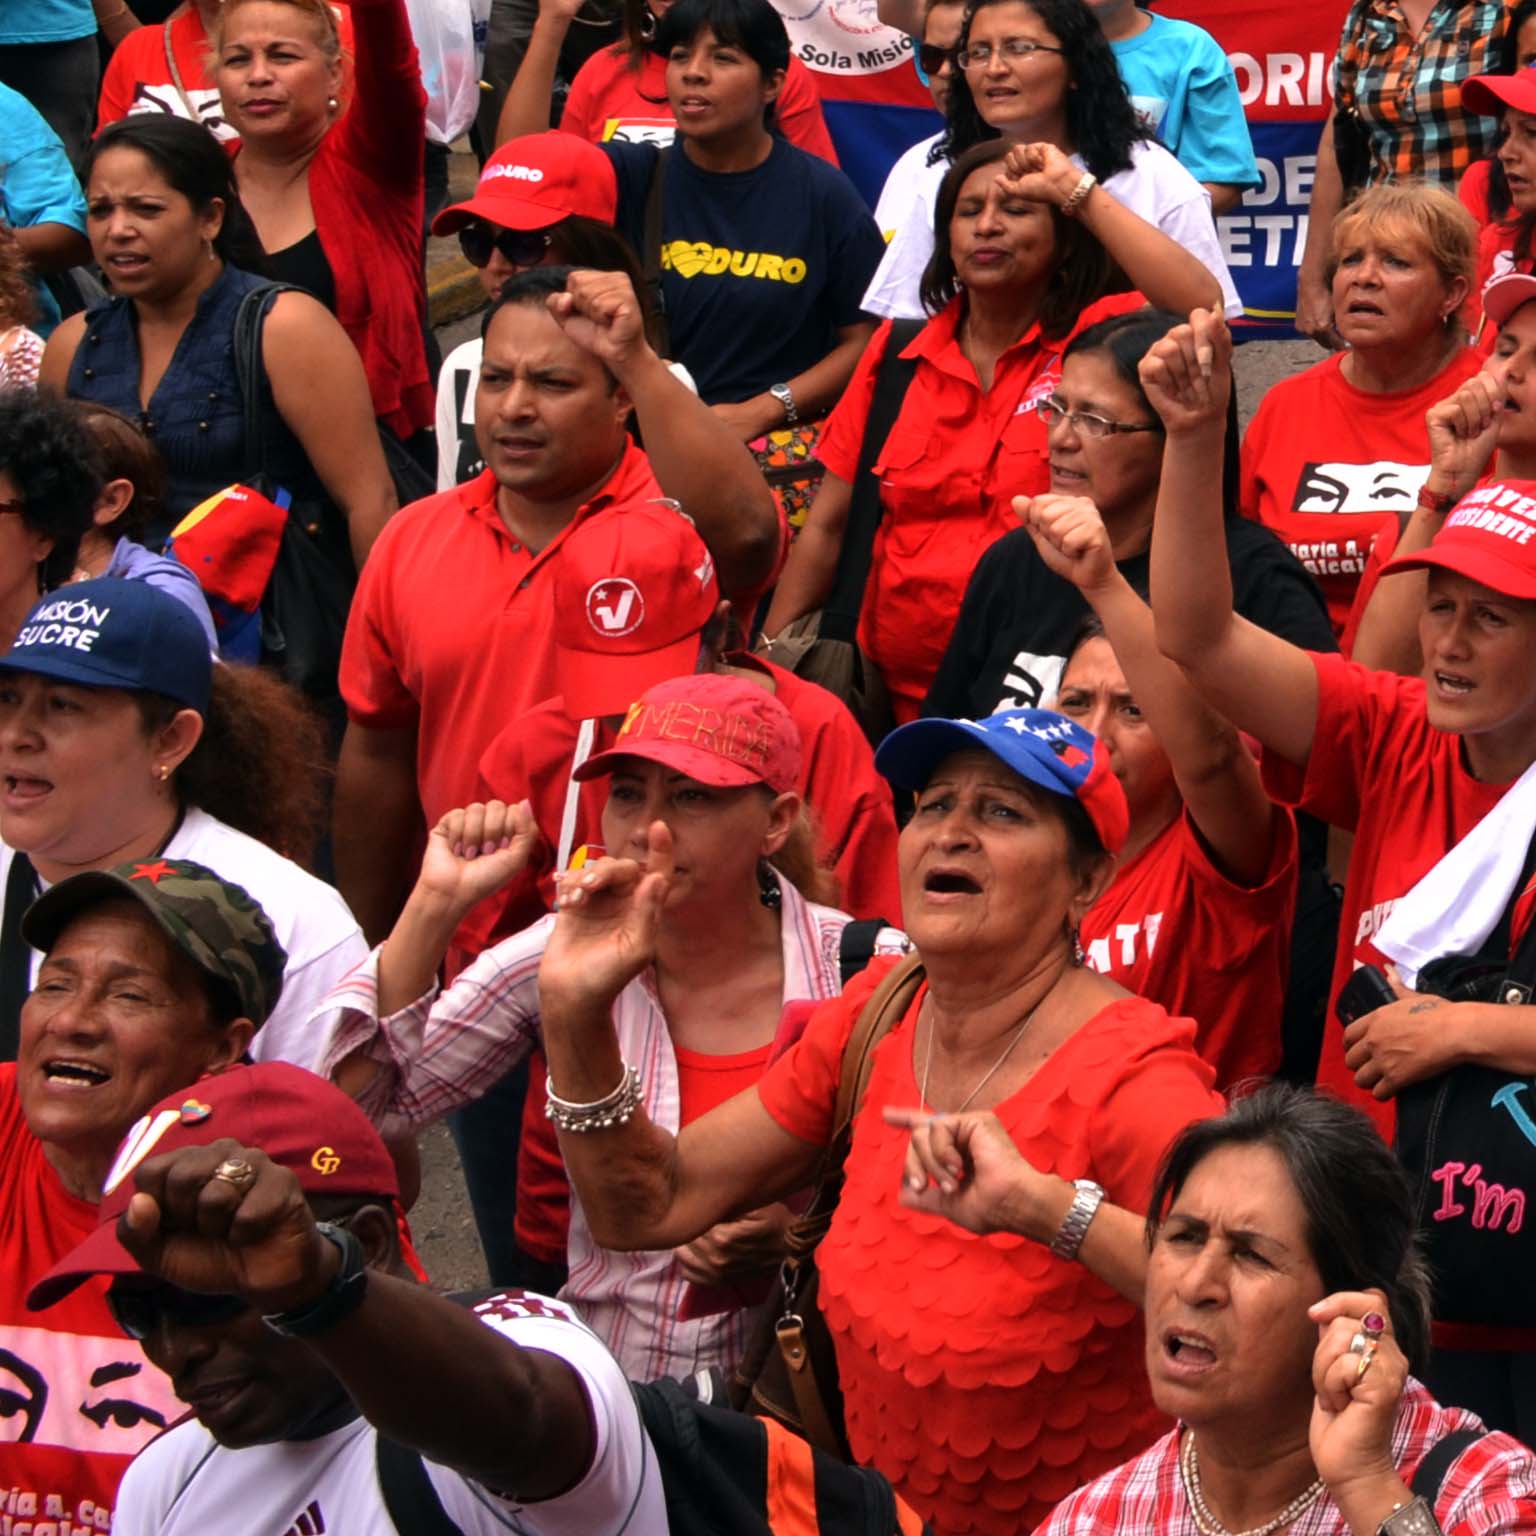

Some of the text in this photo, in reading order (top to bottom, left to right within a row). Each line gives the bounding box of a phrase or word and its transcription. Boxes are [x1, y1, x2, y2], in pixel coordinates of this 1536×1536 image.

[798, 42, 852, 69] Sola
[30, 598, 111, 627] MISIÓN
[13, 622, 101, 652] SUCRE
[1430, 1159, 1528, 1235] I'm
